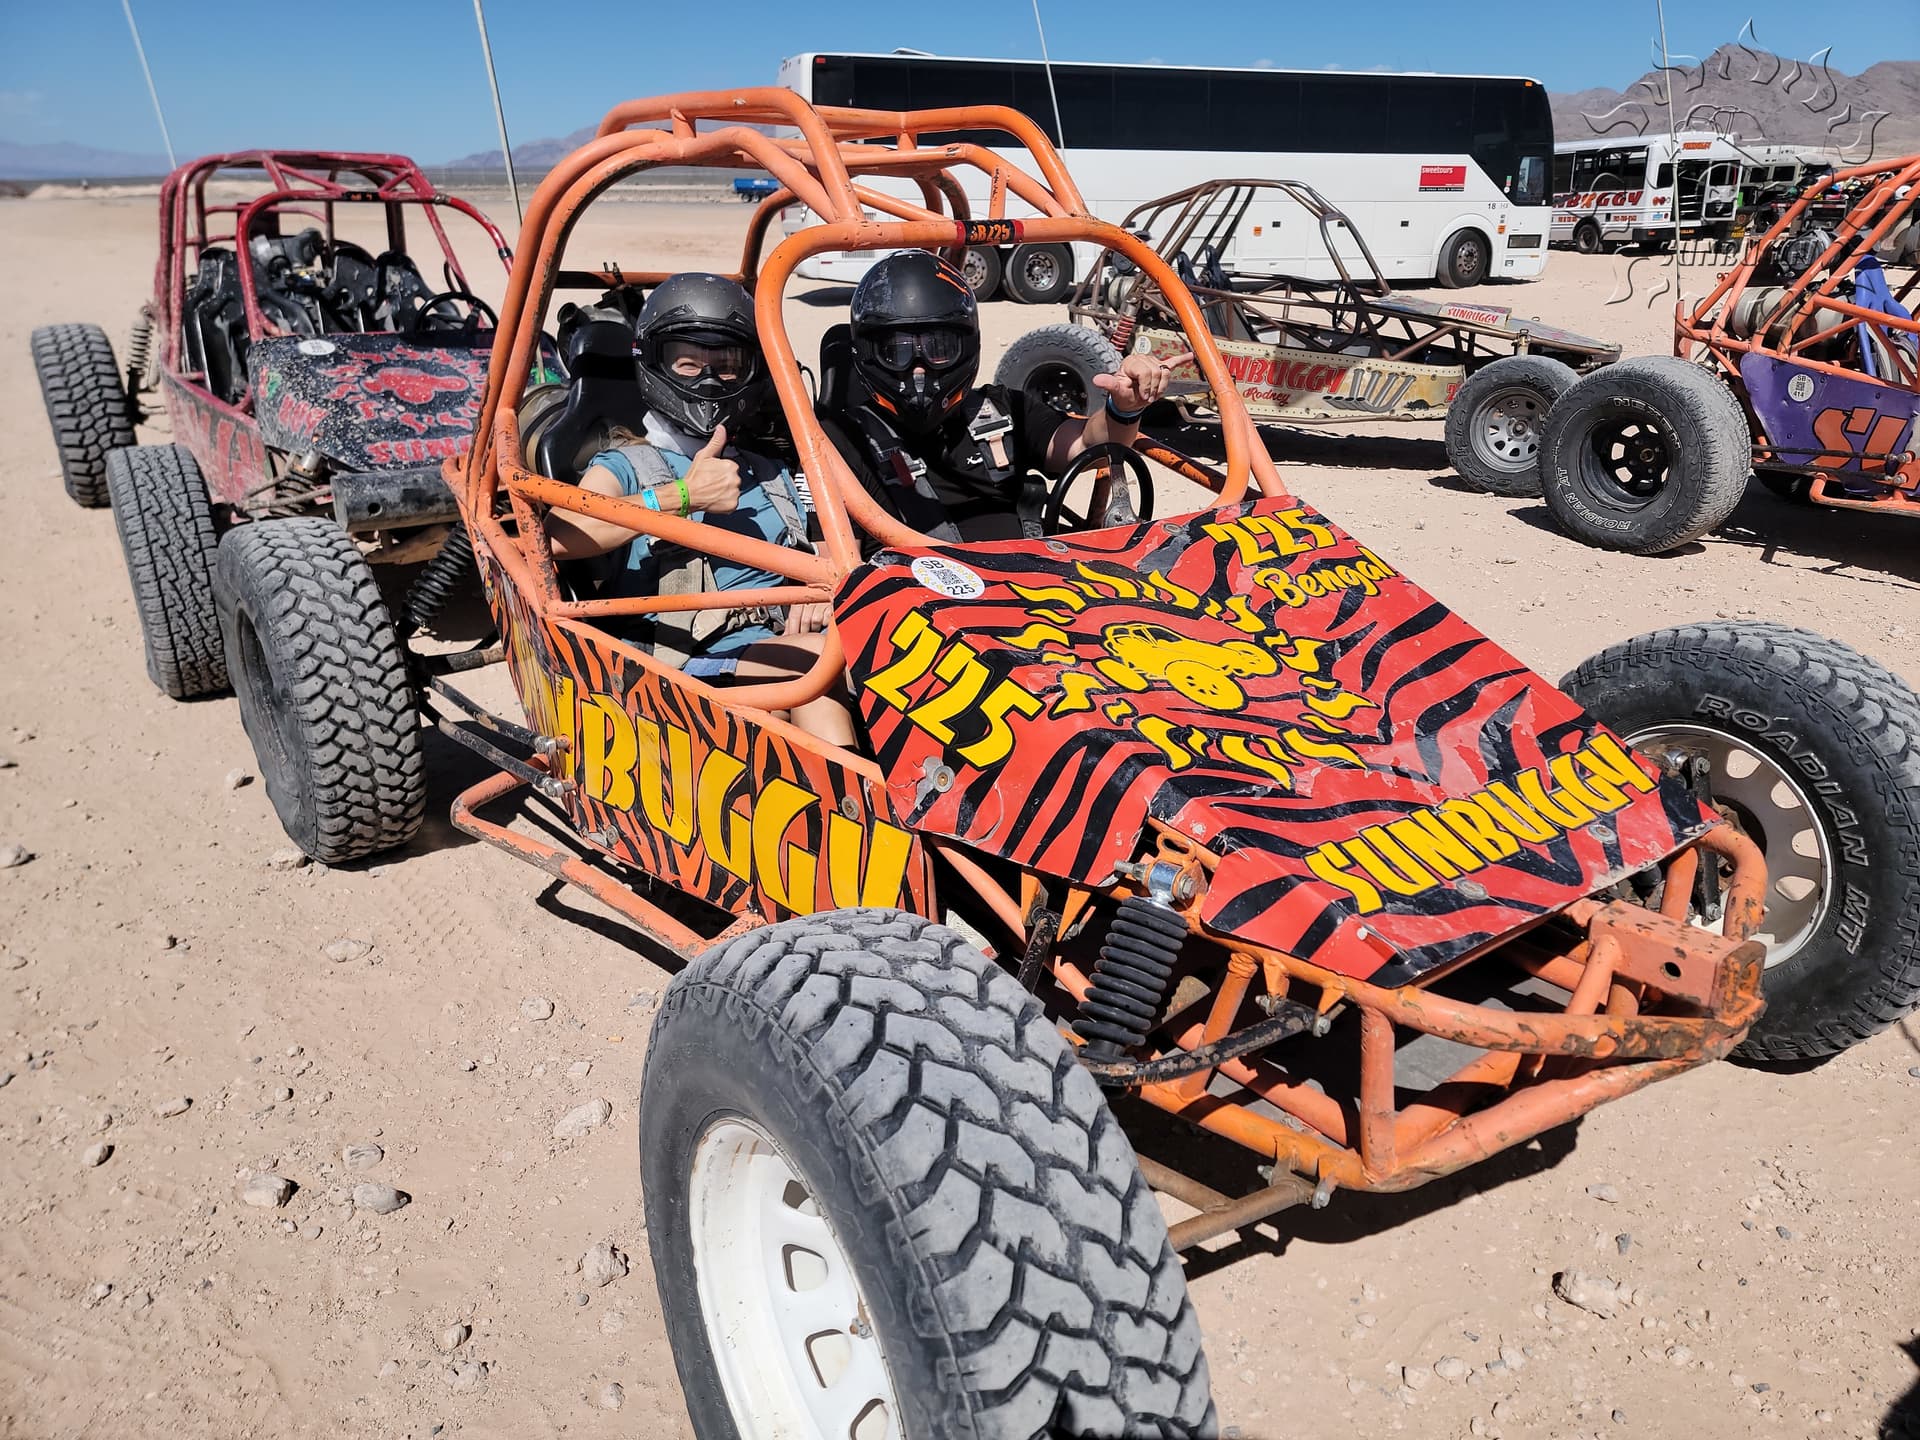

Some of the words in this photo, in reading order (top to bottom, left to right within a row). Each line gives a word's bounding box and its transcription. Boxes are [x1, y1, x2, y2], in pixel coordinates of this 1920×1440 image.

[1447, 306, 1499, 324] SUNBUGGY
[1243, 387, 1292, 406] Rodney
[364, 435, 472, 463] SUN
[1557, 466, 1571, 487] AT
[1565, 492, 1632, 530] ROADIAN
[1201, 508, 1337, 566] 225
[920, 560, 945, 570] SB
[1252, 546, 1398, 607] Bengal
[946, 584, 976, 595] 225
[862, 609, 1045, 768] 225
[1304, 732, 1660, 915] SUNBUGGY
[1696, 693, 1870, 869] ROADIAN
[1836, 883, 1871, 954] MT
